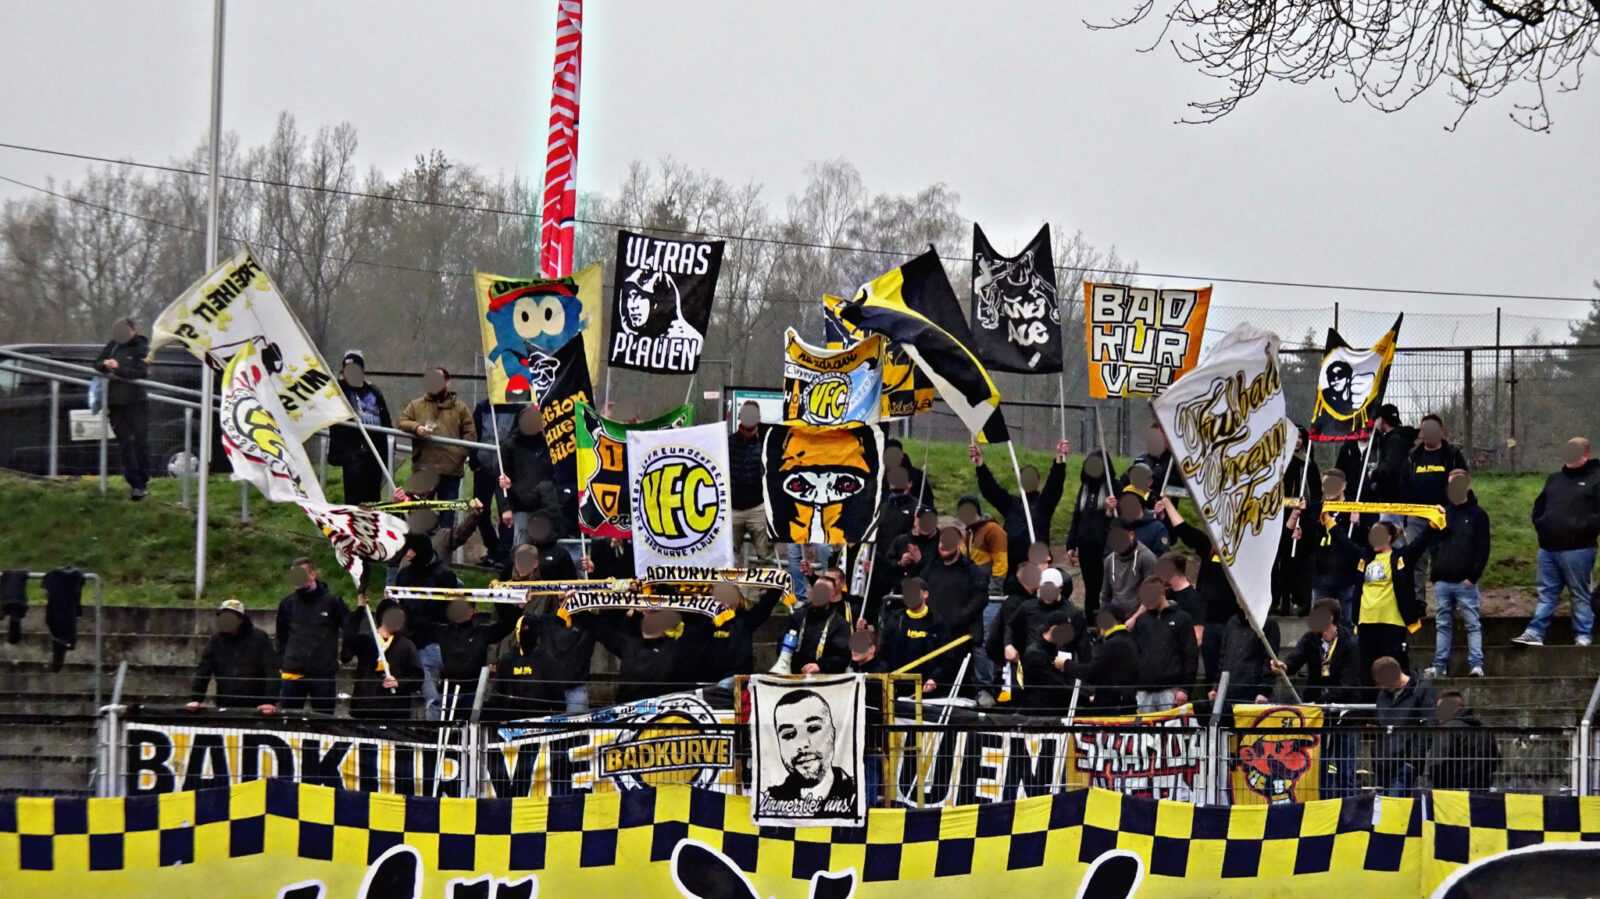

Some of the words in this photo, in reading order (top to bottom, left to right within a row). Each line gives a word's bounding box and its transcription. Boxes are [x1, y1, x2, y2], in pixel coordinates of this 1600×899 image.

[626, 236, 712, 275] ULTRAS
[1092, 285, 1197, 328] BAD
[611, 331, 698, 372] PLAUEN
[1092, 323, 1190, 369] KUR
[1101, 363, 1172, 396] VE!
[809, 381, 848, 418] VFC
[641, 463, 719, 540] VFC
[645, 566, 719, 581] ADKURVE
[605, 738, 730, 772] BADKURVE
[758, 790, 801, 814] Immer
[801, 792, 822, 814] bei
[823, 793, 856, 813] uns!
